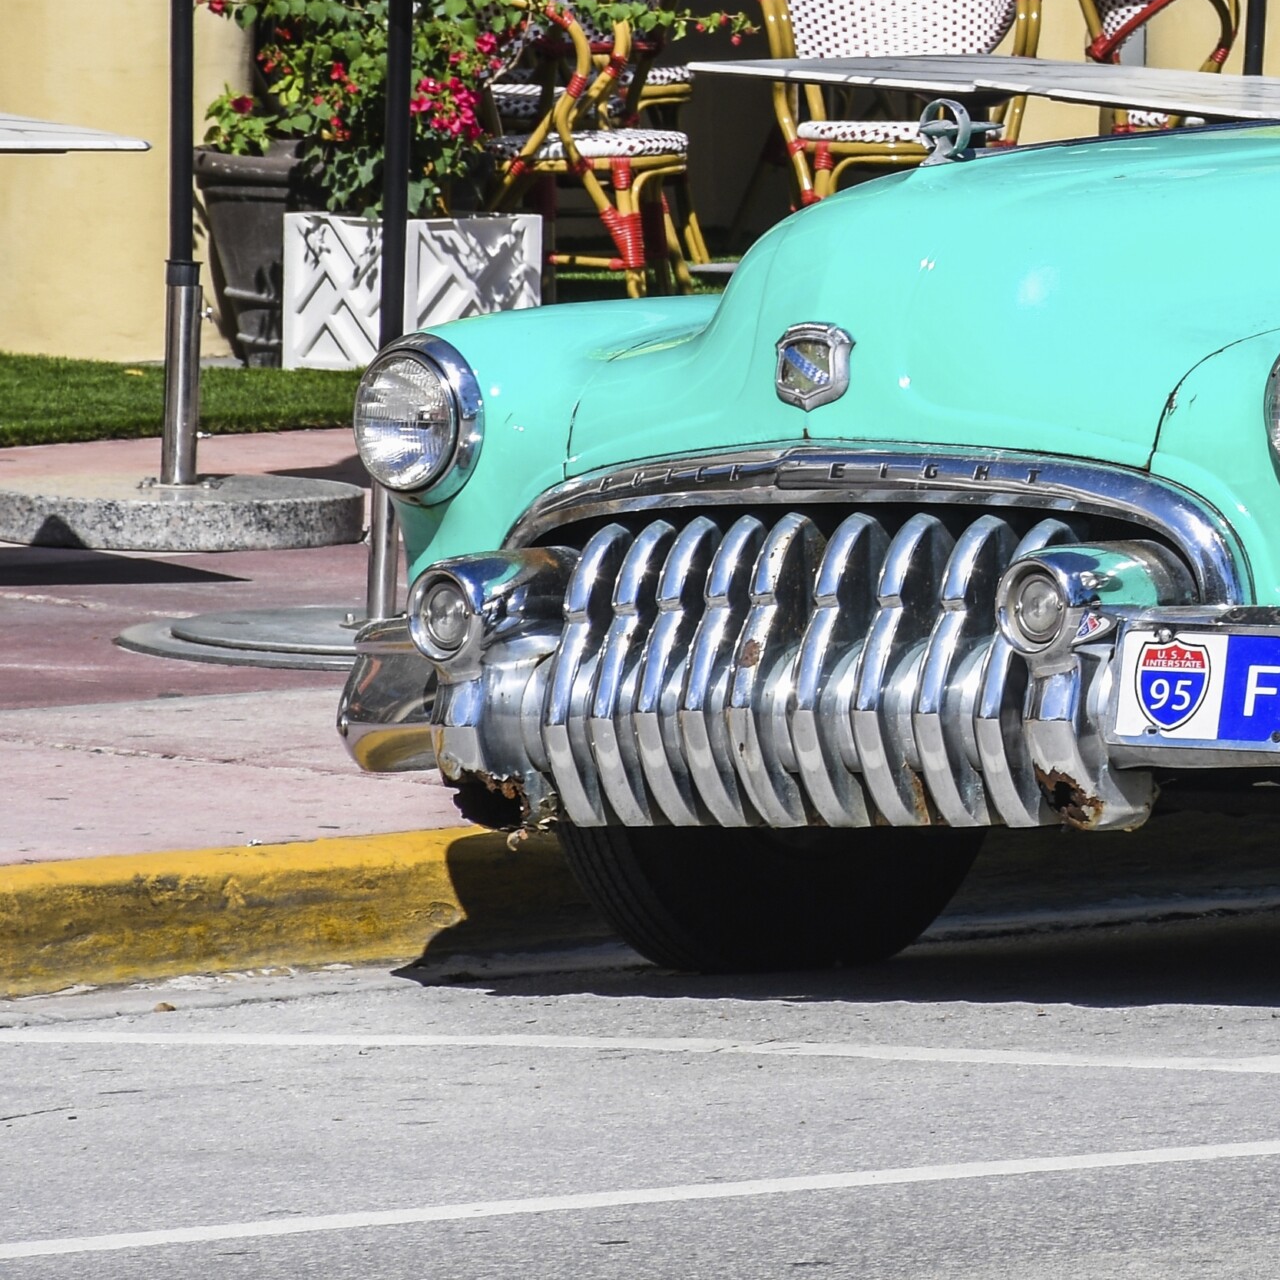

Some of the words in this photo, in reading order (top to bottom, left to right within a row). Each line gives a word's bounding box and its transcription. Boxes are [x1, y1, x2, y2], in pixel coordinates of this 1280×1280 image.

[828, 462, 1042, 484] EIGHT
[1145, 658, 1203, 669] INTERSTATE
[1150, 678, 1192, 711] 95
